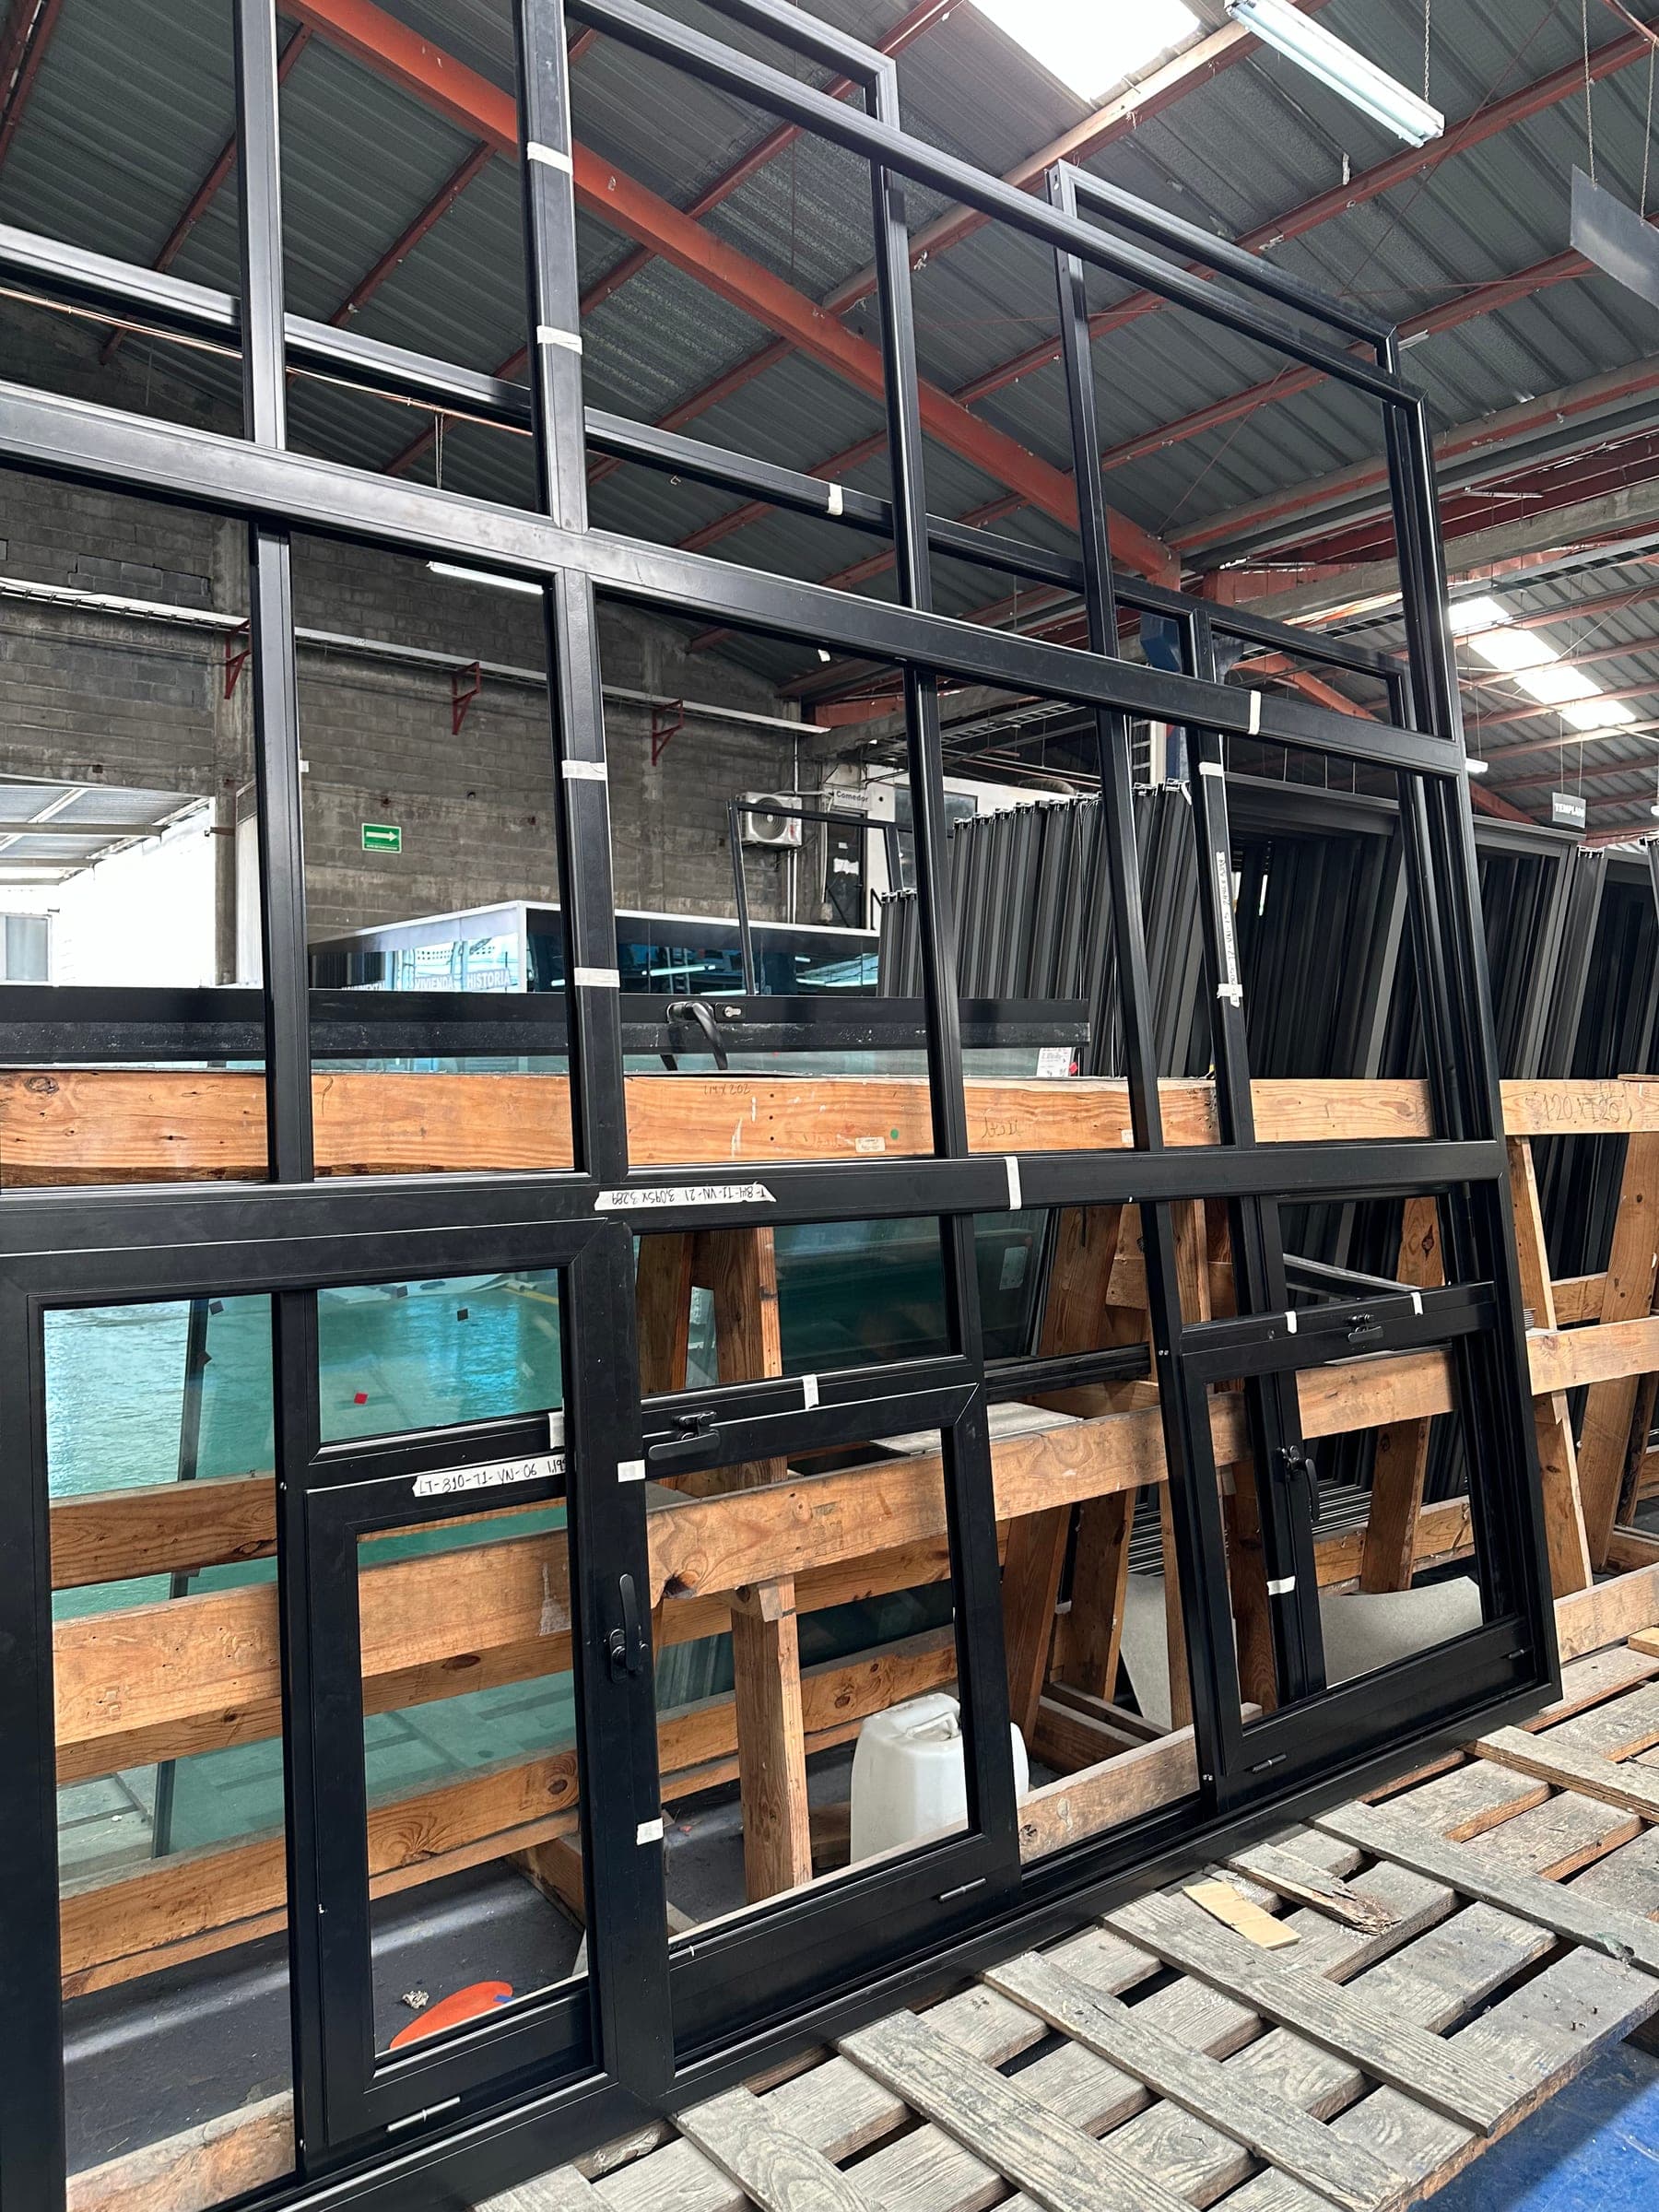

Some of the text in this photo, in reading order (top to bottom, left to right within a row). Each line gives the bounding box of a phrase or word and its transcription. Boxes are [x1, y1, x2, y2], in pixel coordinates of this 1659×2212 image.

[836, 790, 869, 803] Comedor
[415, 975, 454, 989] VIVIENDA
[465, 969, 511, 989] HISTORIA
